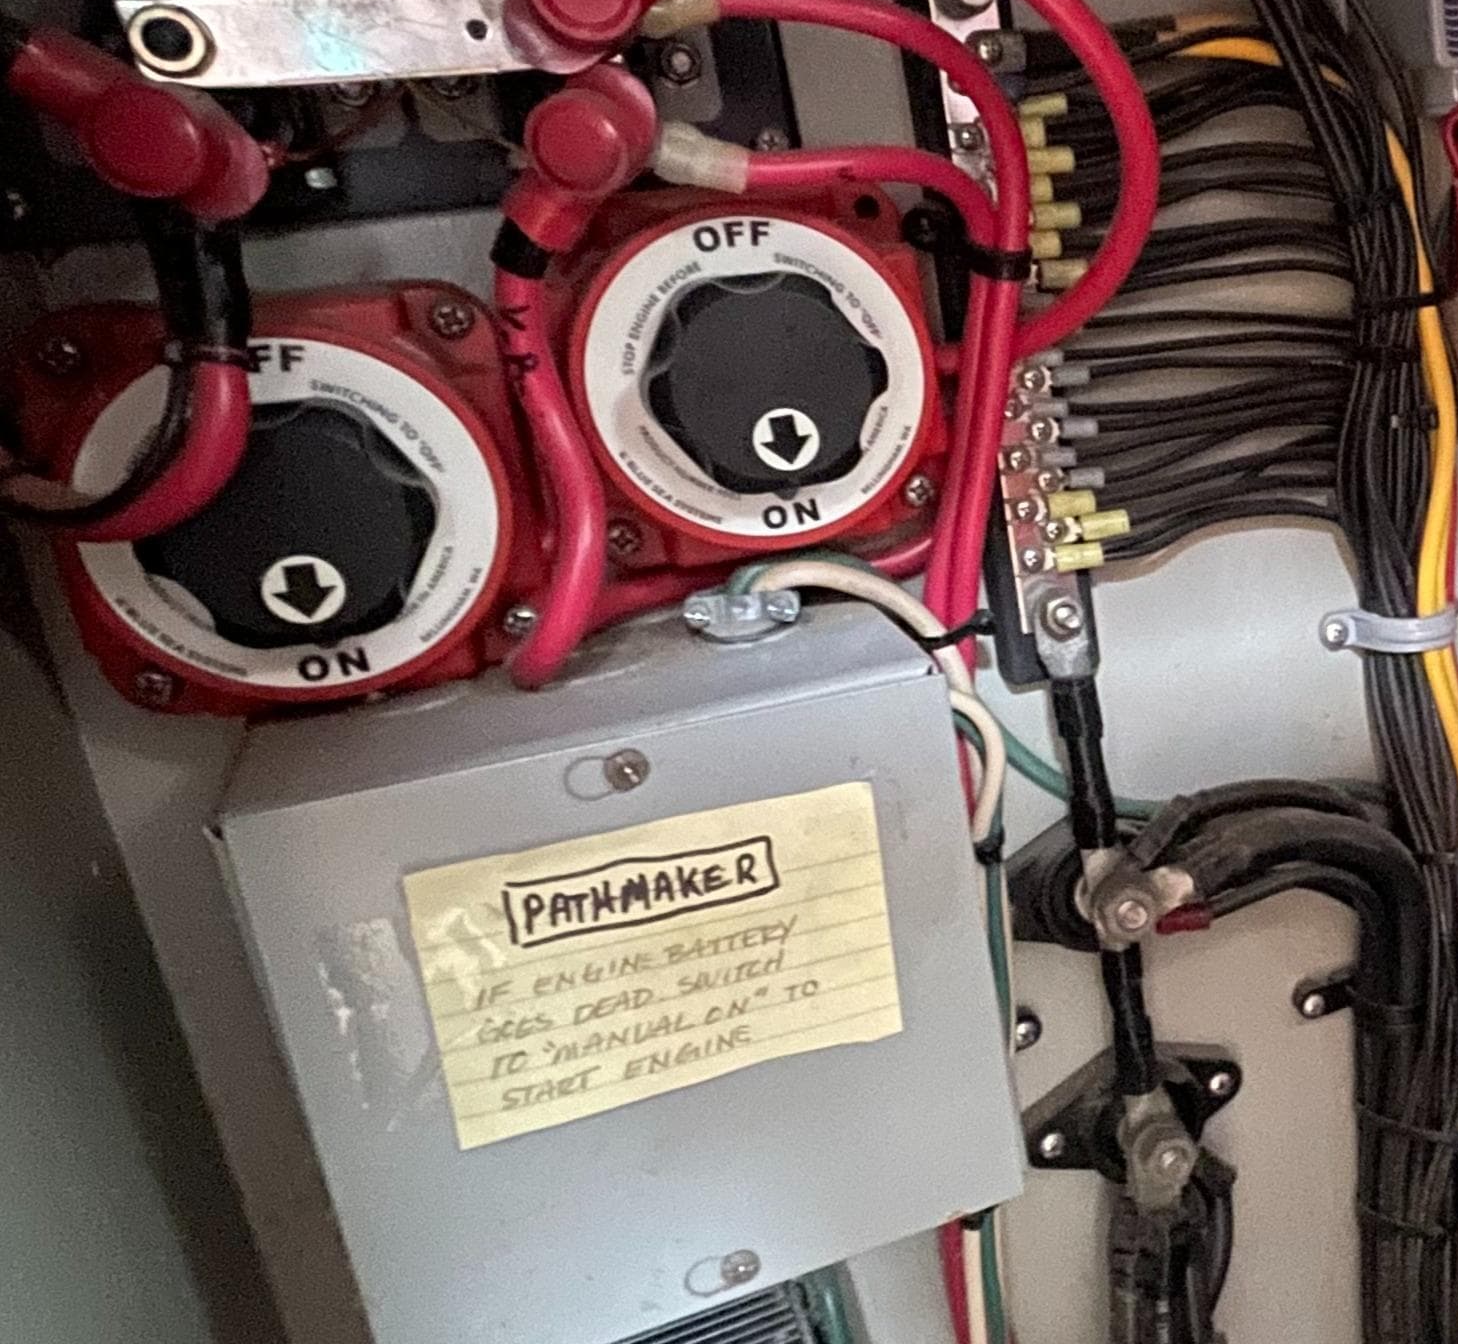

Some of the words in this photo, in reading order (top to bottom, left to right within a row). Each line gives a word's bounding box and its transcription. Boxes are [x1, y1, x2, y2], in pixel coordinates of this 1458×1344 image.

[692, 221, 770, 253] OFF
[773, 252, 846, 295] SWITCHING
[845, 290, 862, 310] TO
[622, 332, 640, 375] STOP
[633, 292, 661, 334] ENGINE
[656, 261, 702, 294] BEFORE
[246, 343, 305, 374] FF
[310, 378, 399, 425] SWITCHING
[400, 419, 419, 441] TO
[762, 498, 821, 529] ON
[298, 647, 371, 682] ON
[522, 852, 758, 935] PATHMAKER
[475, 979, 514, 1011] IF
[663, 913, 799, 968] BATTERY
[476, 1012, 554, 1047] GOES
[676, 950, 787, 998] SWITCH
[489, 1049, 528, 1080] TO
[784, 979, 821, 1003] TO
[500, 1064, 603, 1110] START
[623, 1024, 754, 1081] ENGINE
